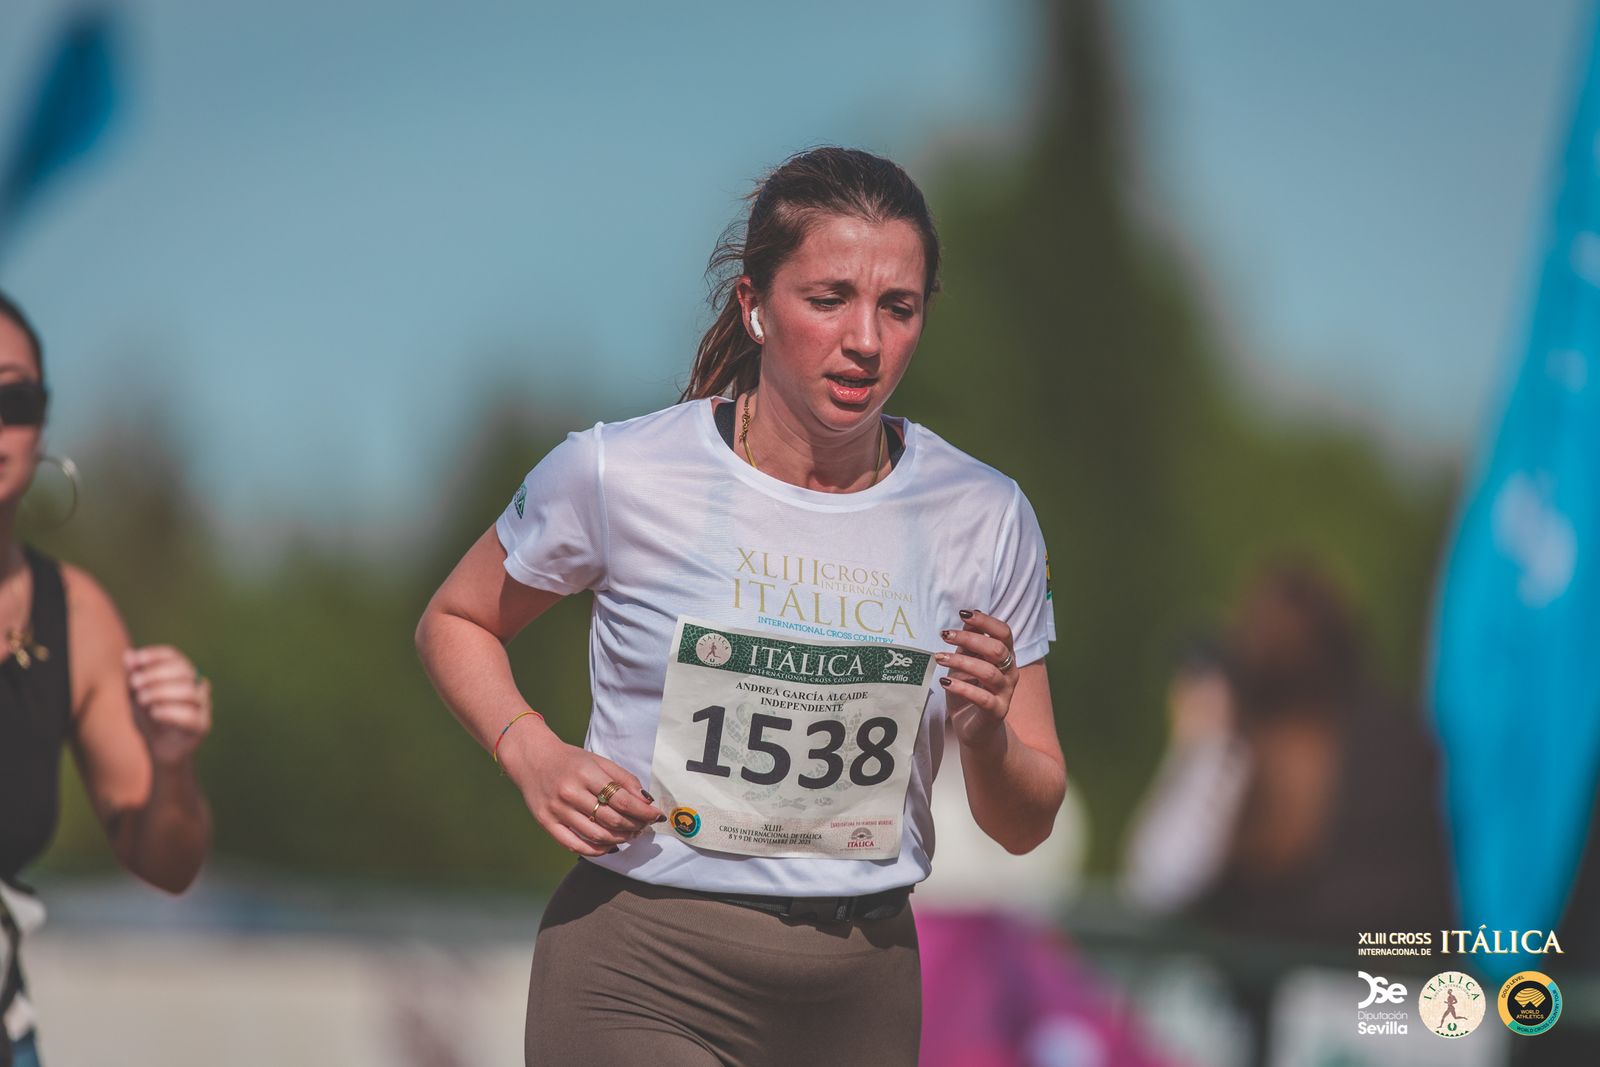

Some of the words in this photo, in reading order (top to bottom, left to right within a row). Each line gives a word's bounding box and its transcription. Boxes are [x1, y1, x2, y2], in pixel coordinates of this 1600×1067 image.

[737, 547, 819, 585] XLIII
[821, 563, 890, 588] CROSS
[821, 580, 913, 602] INTERNACIONAL
[733, 577, 917, 639] ITÁLICA
[757, 616, 825, 636] INTERNATIONAL
[826, 628, 852, 641] CROSS
[853, 633, 894, 644] COUNTRY
[748, 645, 865, 676] ITÁLICA
[748, 667, 807, 681] INTERNATIONAL
[881, 674, 908, 682] Sevilla
[736, 682, 779, 696] ANDREA
[782, 689, 824, 701] GARCÍA
[826, 691, 869, 701] ALCAIDE
[760, 697, 844, 712] INDEPENDIENTE
[686, 705, 898, 789] 1538
[719, 825, 739, 834] CROSS
[740, 829, 789, 839] INTERNACIONAL
